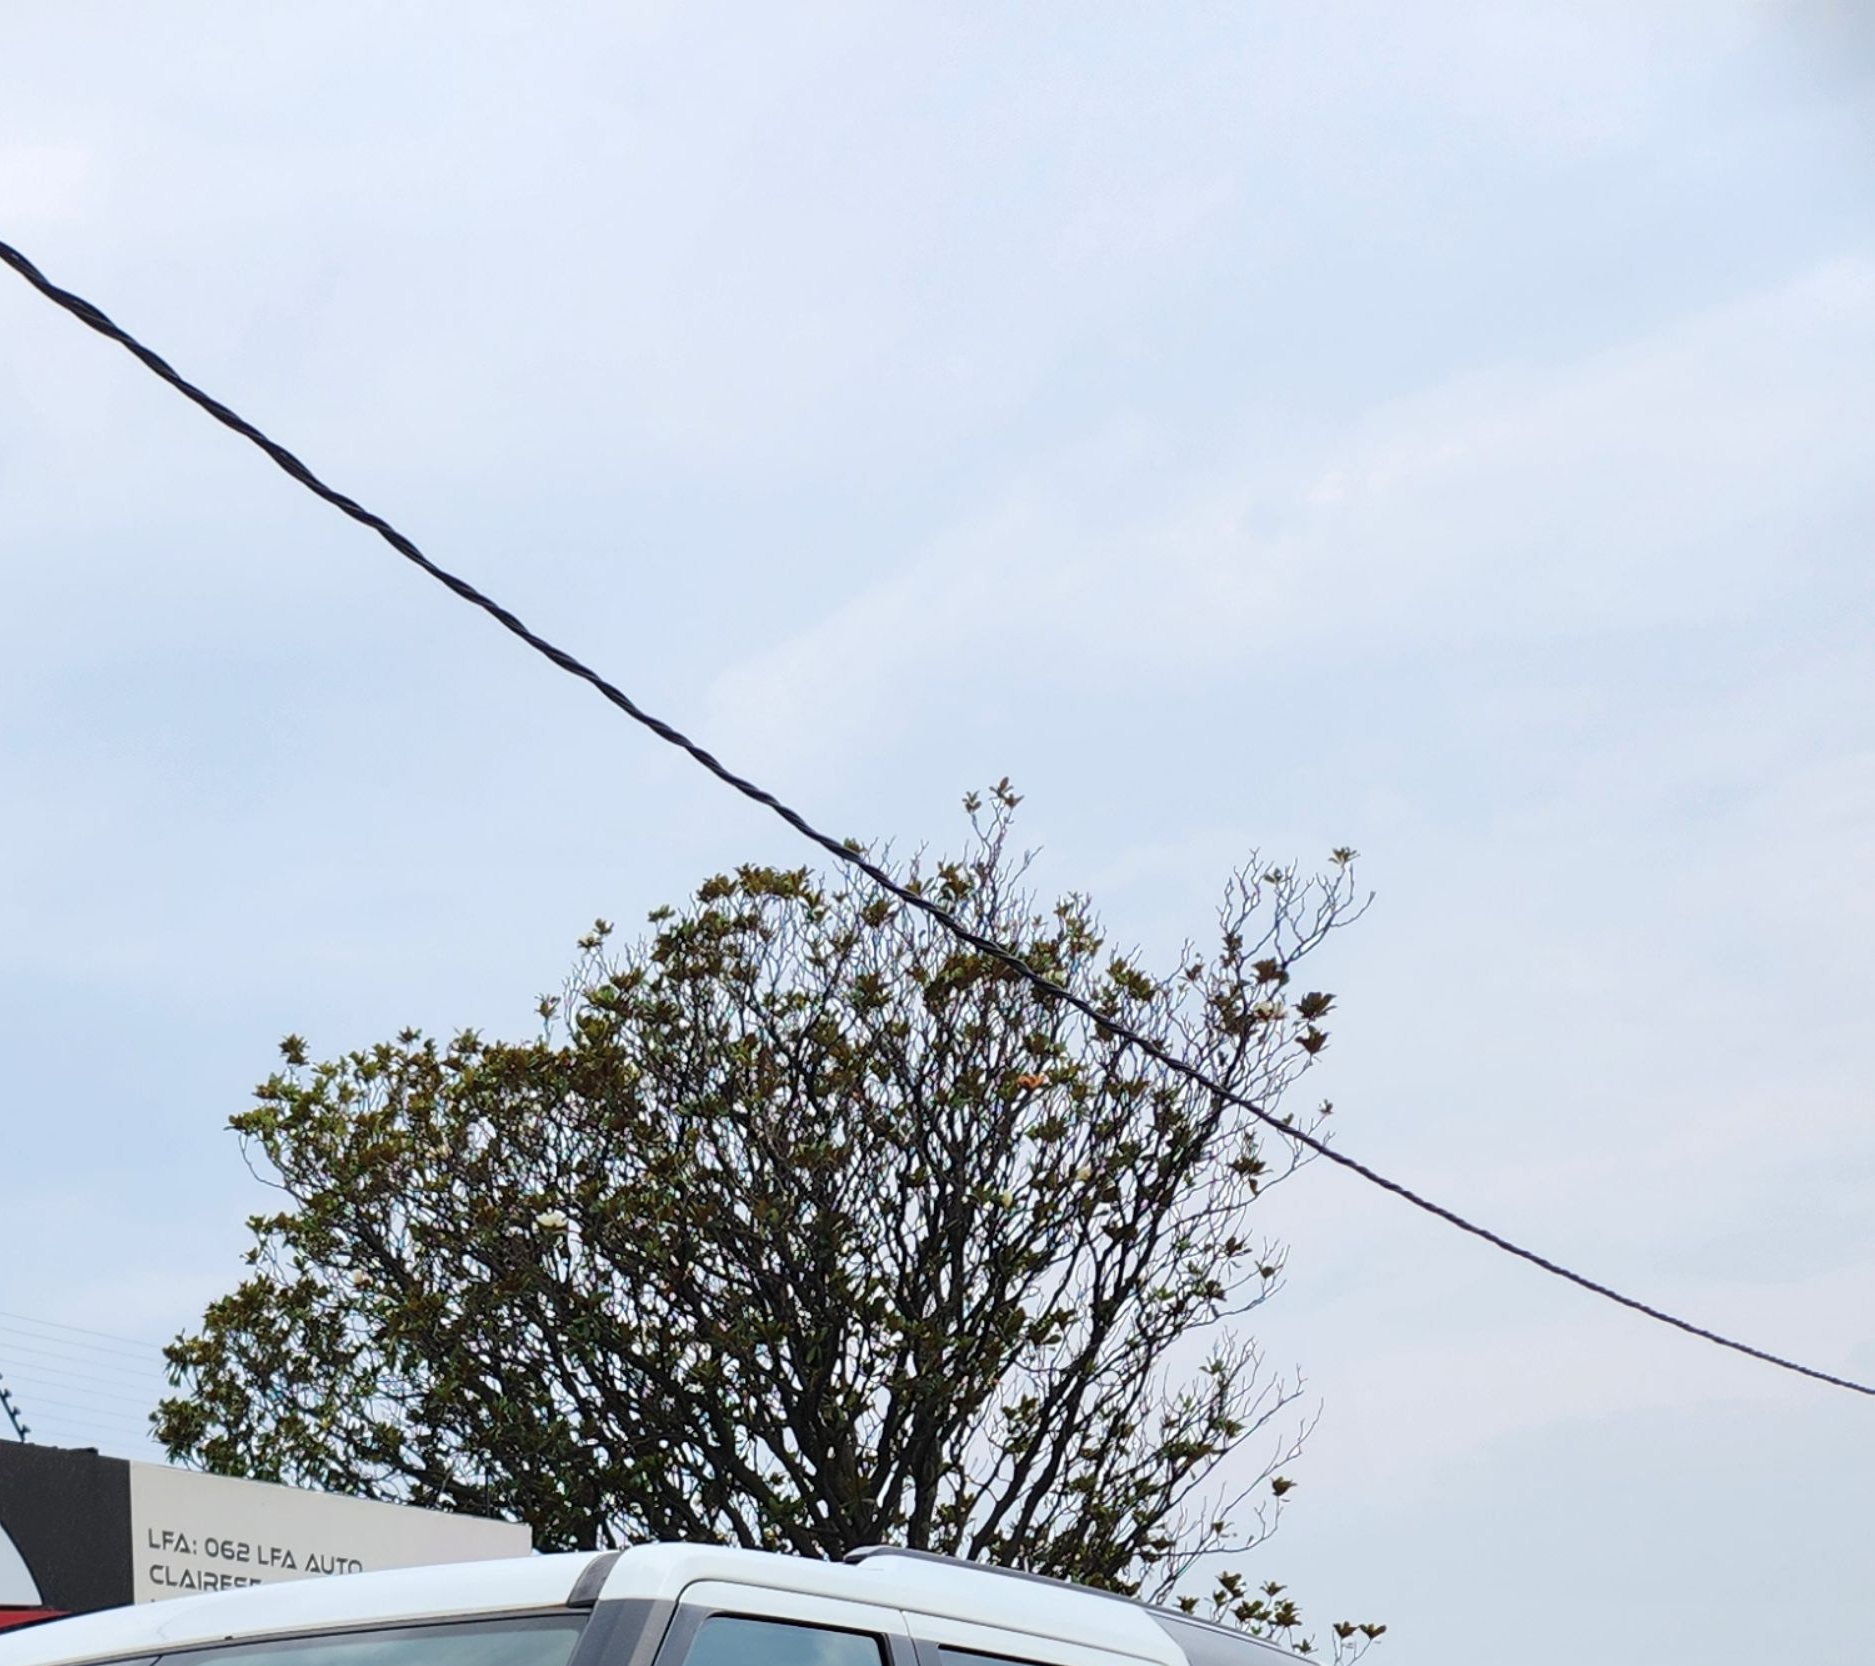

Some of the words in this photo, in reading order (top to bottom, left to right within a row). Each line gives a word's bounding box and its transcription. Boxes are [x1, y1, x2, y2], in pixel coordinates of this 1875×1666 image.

[148, 1528, 197, 1555] LFA:
[204, 1538, 250, 1562] 062
[258, 1545, 297, 1570] LFA
[305, 1553, 363, 1575] AUTO
